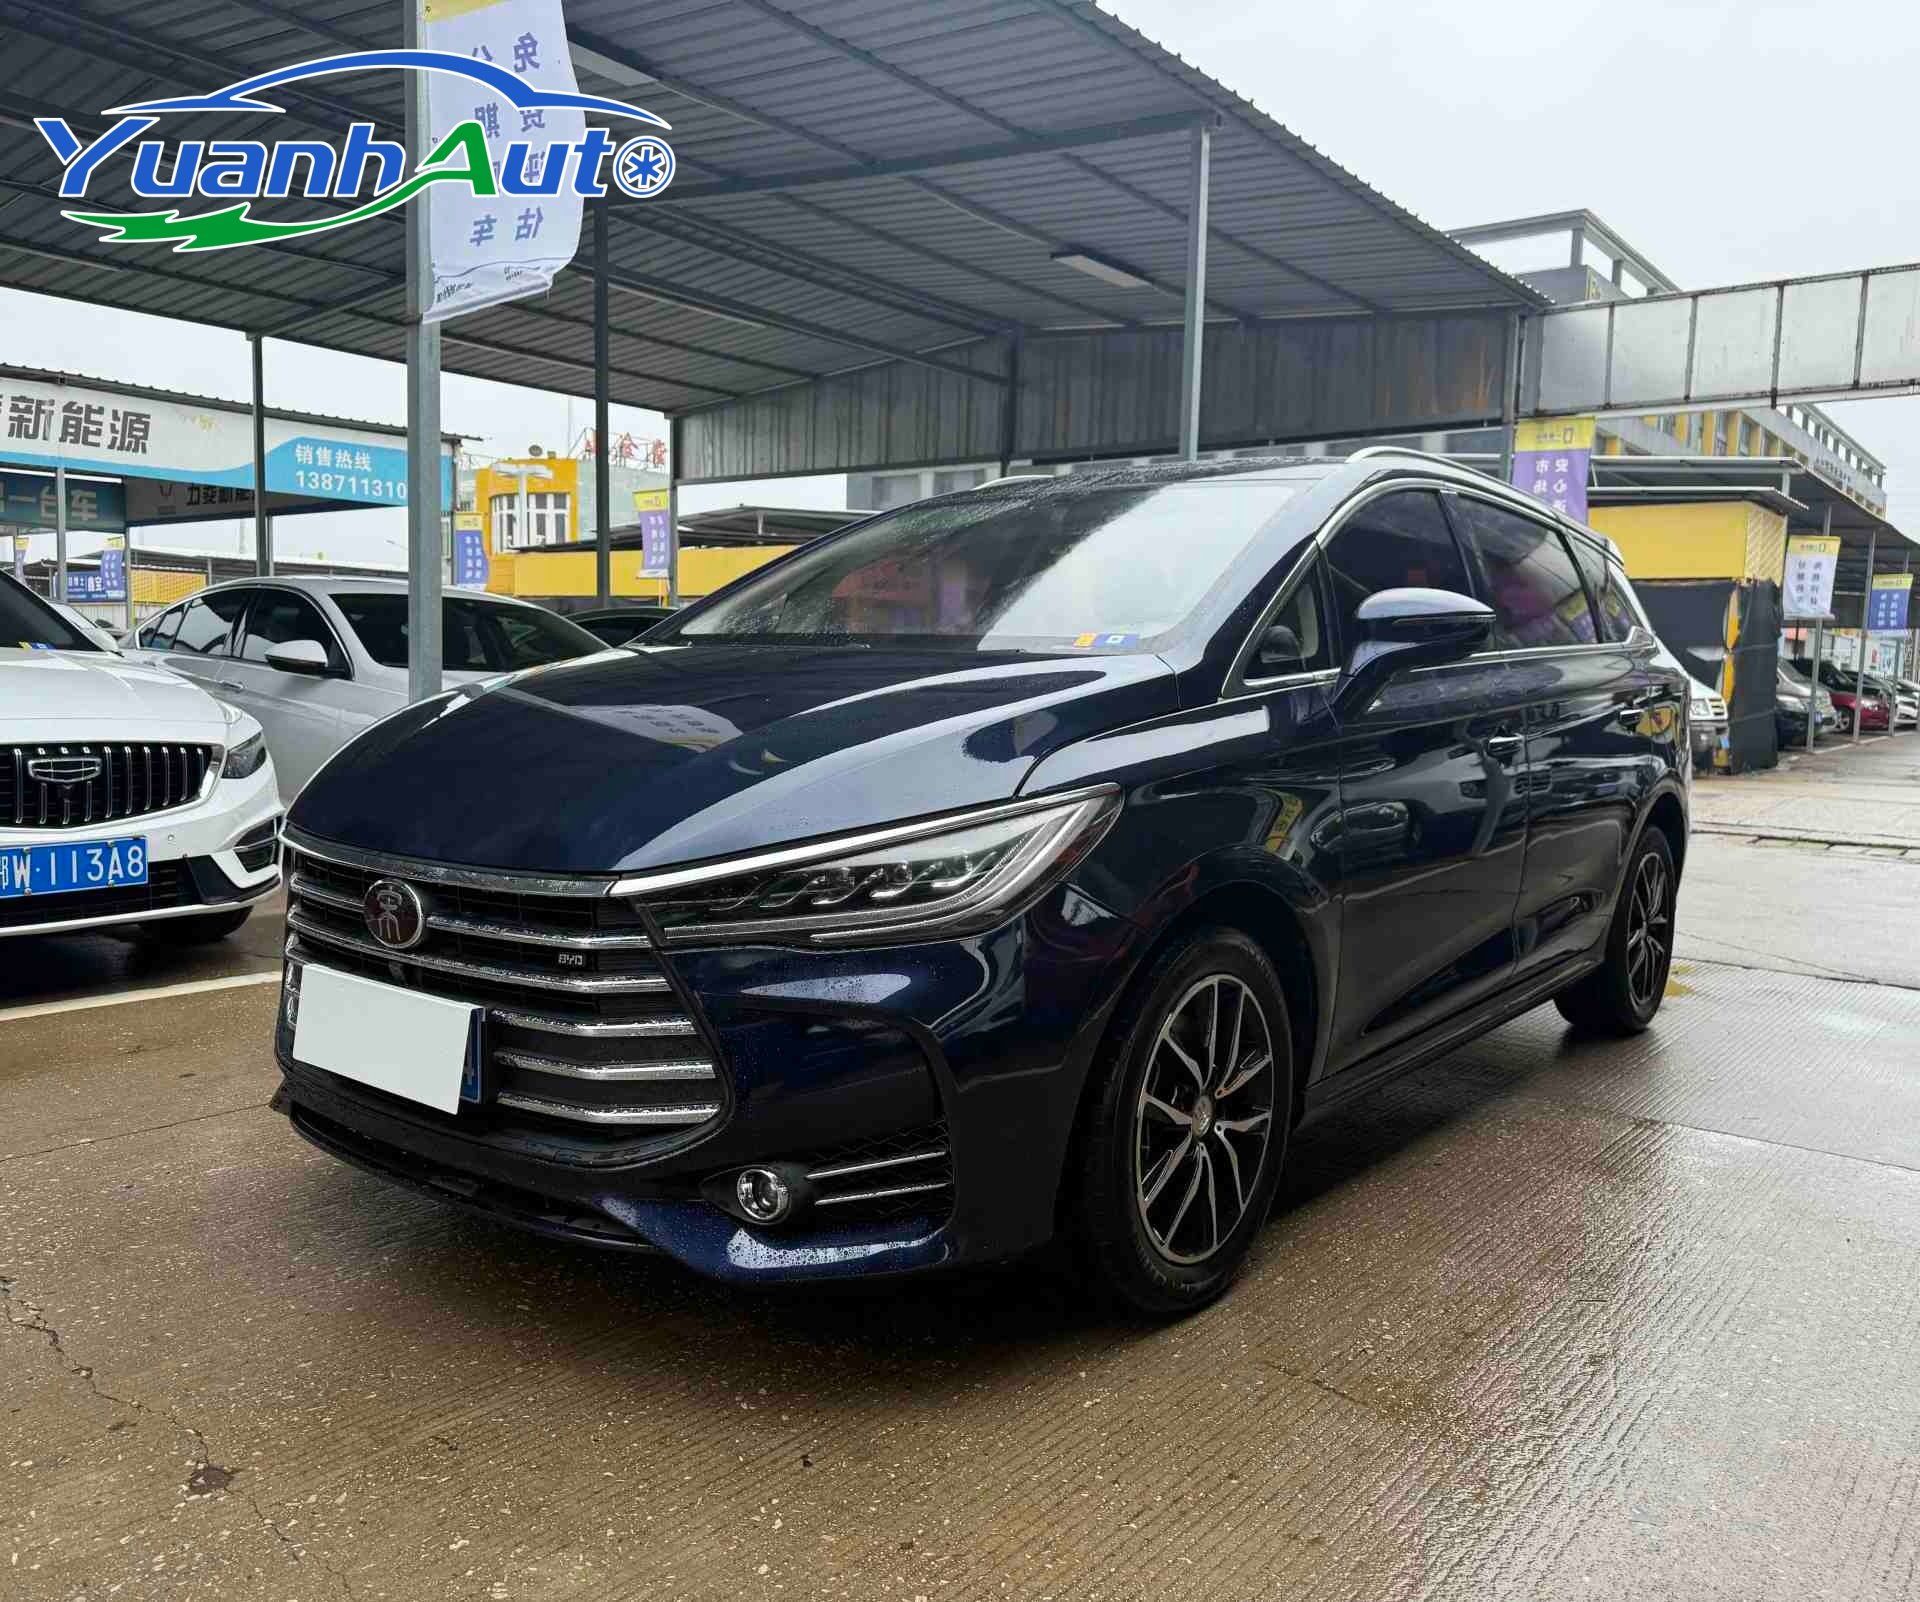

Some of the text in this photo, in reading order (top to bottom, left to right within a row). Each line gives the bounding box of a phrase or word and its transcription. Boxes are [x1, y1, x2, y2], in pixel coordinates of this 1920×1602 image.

[0, 394, 152, 455] 新能源
[295, 443, 372, 472] 销售热线
[295, 469, 408, 499] 138711310
[558, 953, 583, 966] BYD
